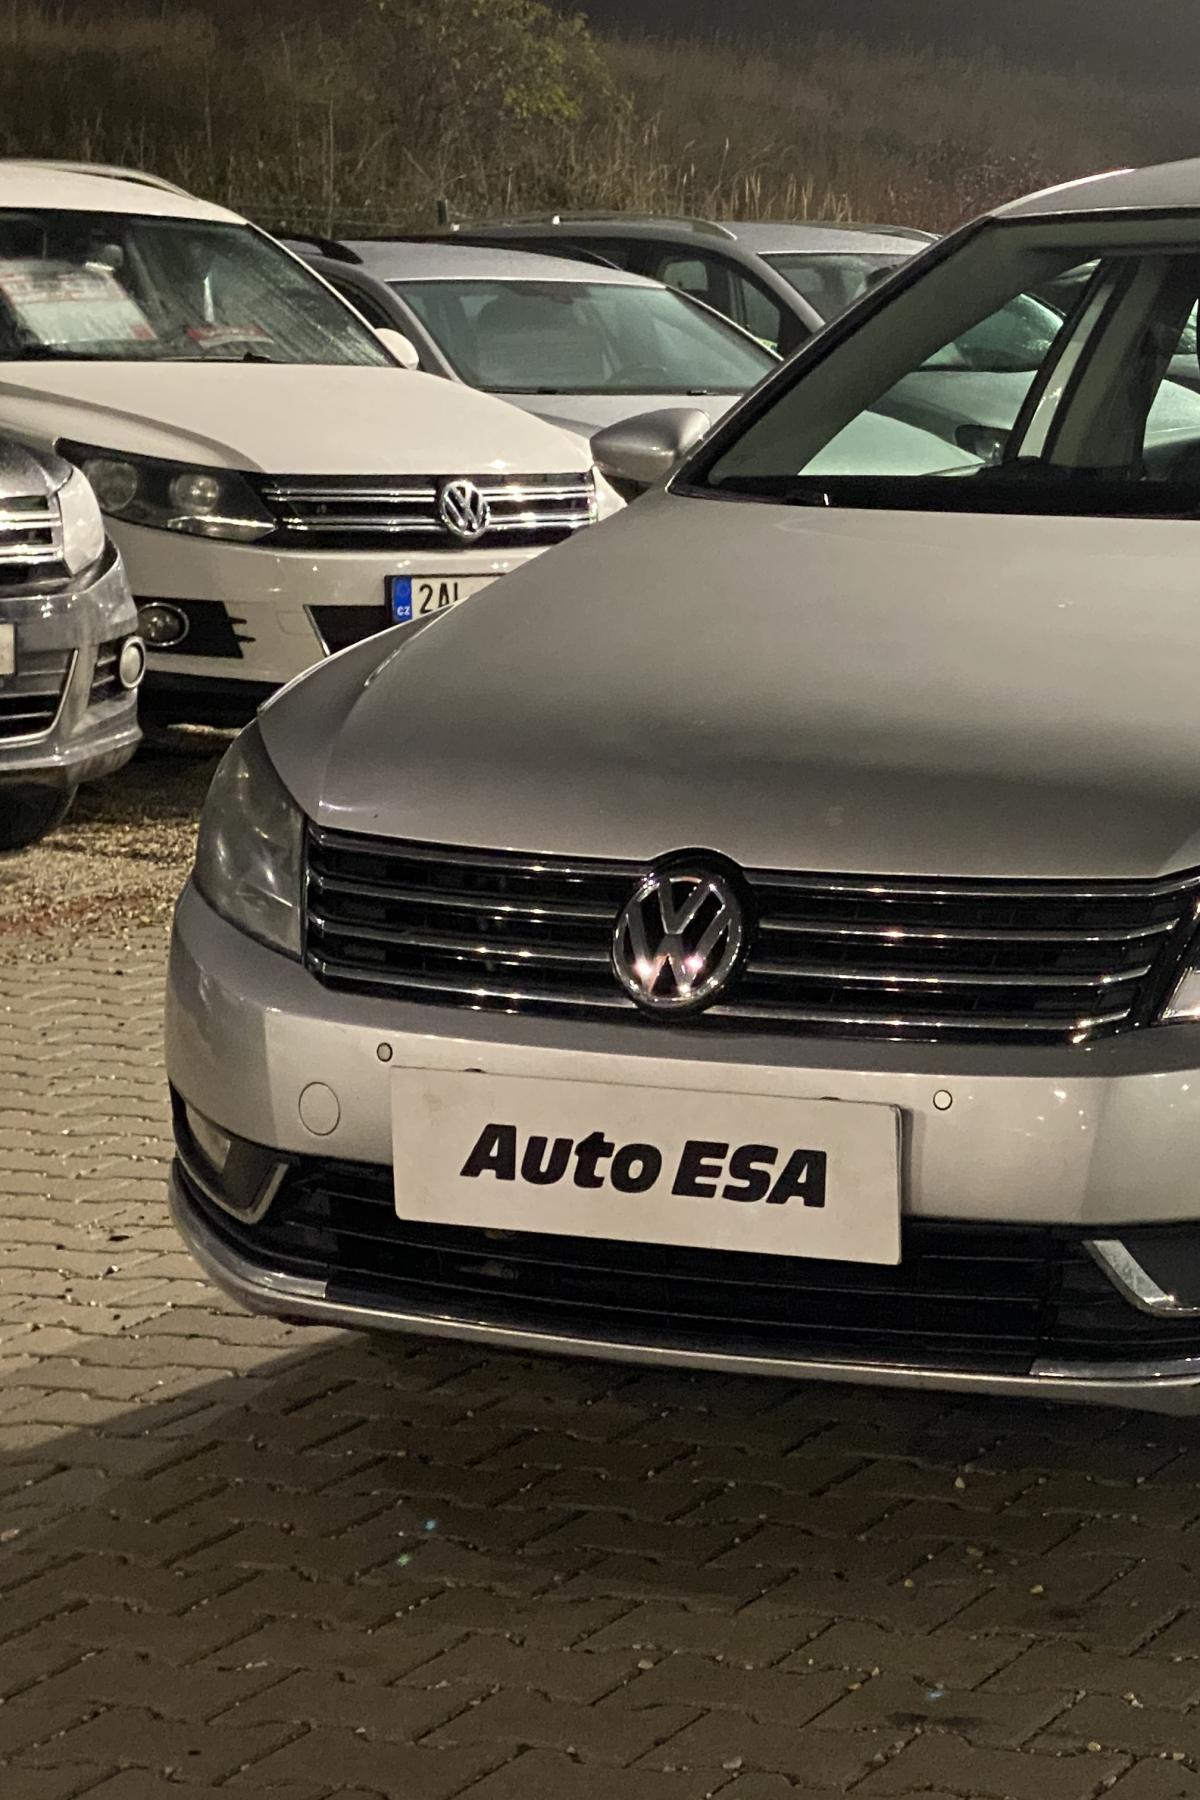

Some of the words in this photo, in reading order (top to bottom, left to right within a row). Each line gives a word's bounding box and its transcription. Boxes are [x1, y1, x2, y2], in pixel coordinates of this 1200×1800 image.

[396, 605, 411, 617] CZ
[613, 872, 741, 1007] VW
[460, 1123, 662, 1194] Auto
[671, 1140, 827, 1208] ESA
